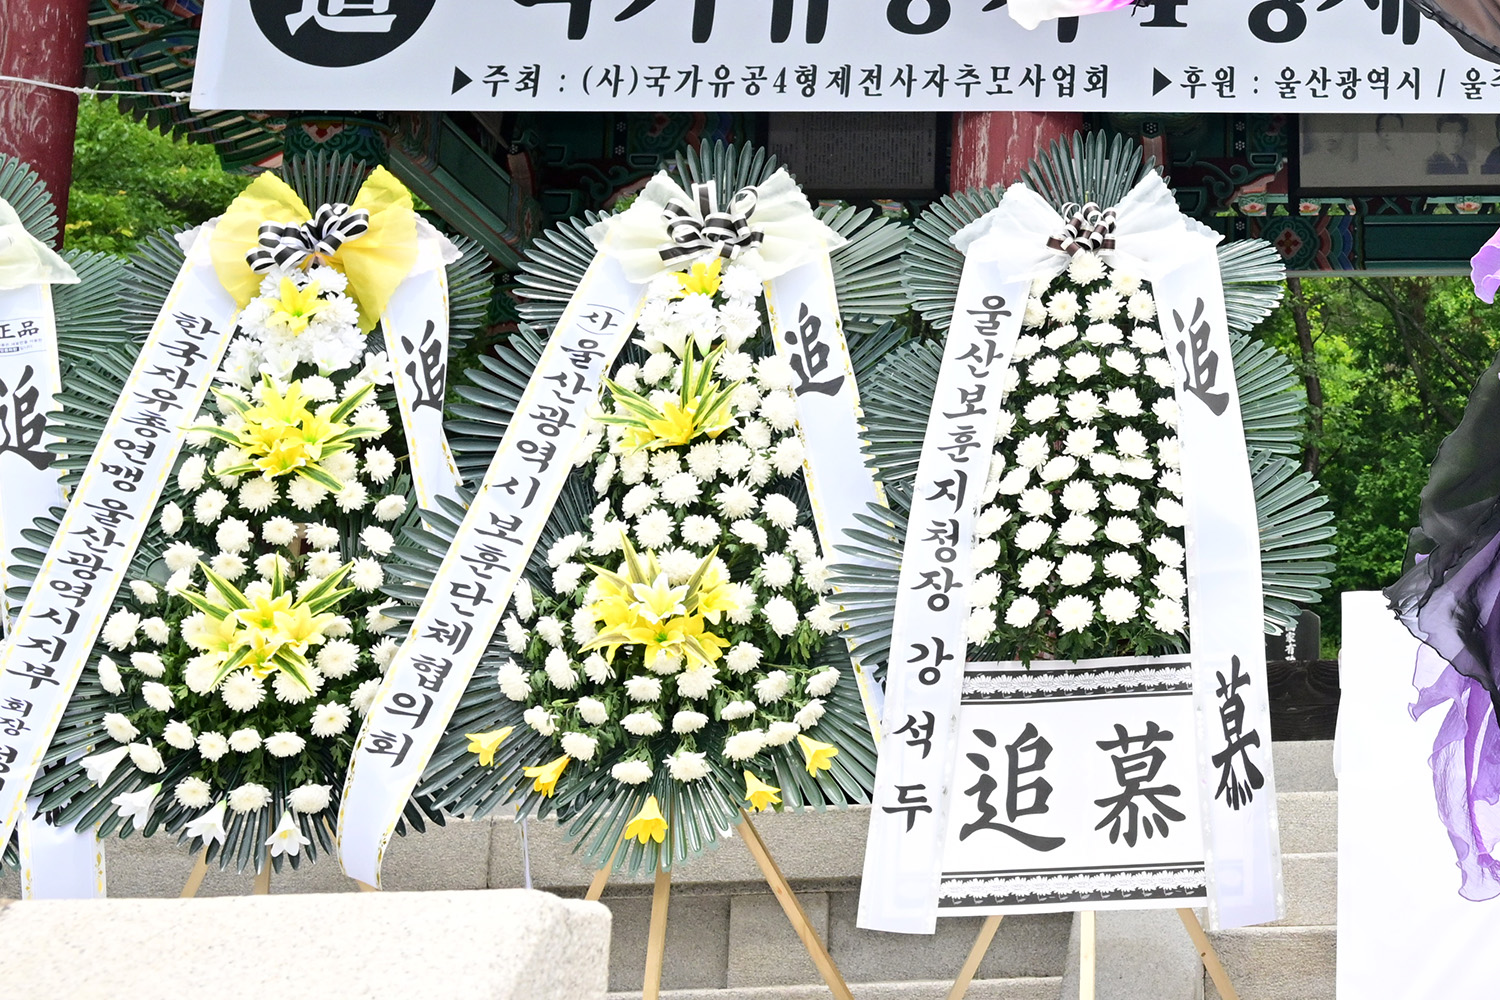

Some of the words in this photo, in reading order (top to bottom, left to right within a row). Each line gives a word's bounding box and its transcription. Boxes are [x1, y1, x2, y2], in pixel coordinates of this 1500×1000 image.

[483, 64, 540, 98] 주최
[582, 64, 1108, 98] (사)국가유공4형제전사자추모사업회
[1180, 66, 1236, 99] 후원
[1275, 66, 1420, 100] 울산광역시
[101, 312, 219, 492] 한국자유총연맹
[785, 302, 844, 397] 追
[1173, 298, 1229, 416] 追
[910, 295, 1012, 612] 울산보훈지청장
[6, 498, 135, 689] 울산광역시지부
